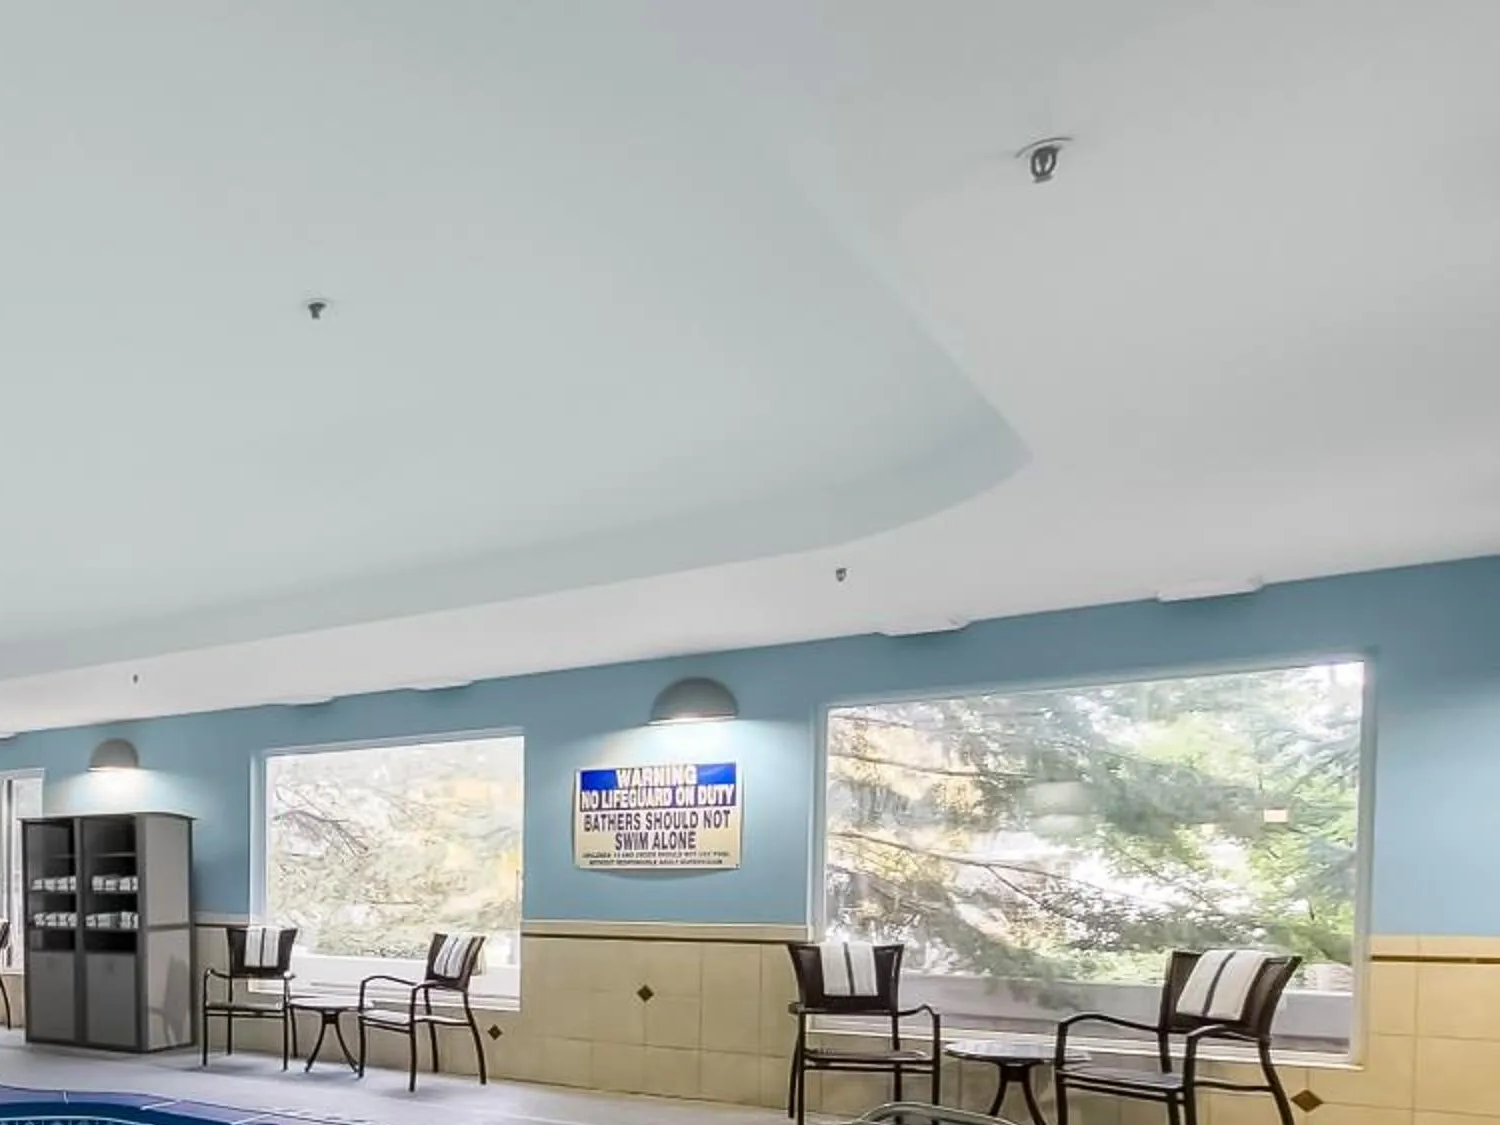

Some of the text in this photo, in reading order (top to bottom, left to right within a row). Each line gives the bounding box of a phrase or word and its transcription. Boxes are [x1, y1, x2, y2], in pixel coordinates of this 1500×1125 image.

[617, 765, 697, 787] WARNING
[581, 784, 734, 810] NO LIFEGUARD ON DUTY
[584, 810, 730, 832] BATHERS SHOULD NOT
[616, 832, 696, 851] SWIM ALONE
